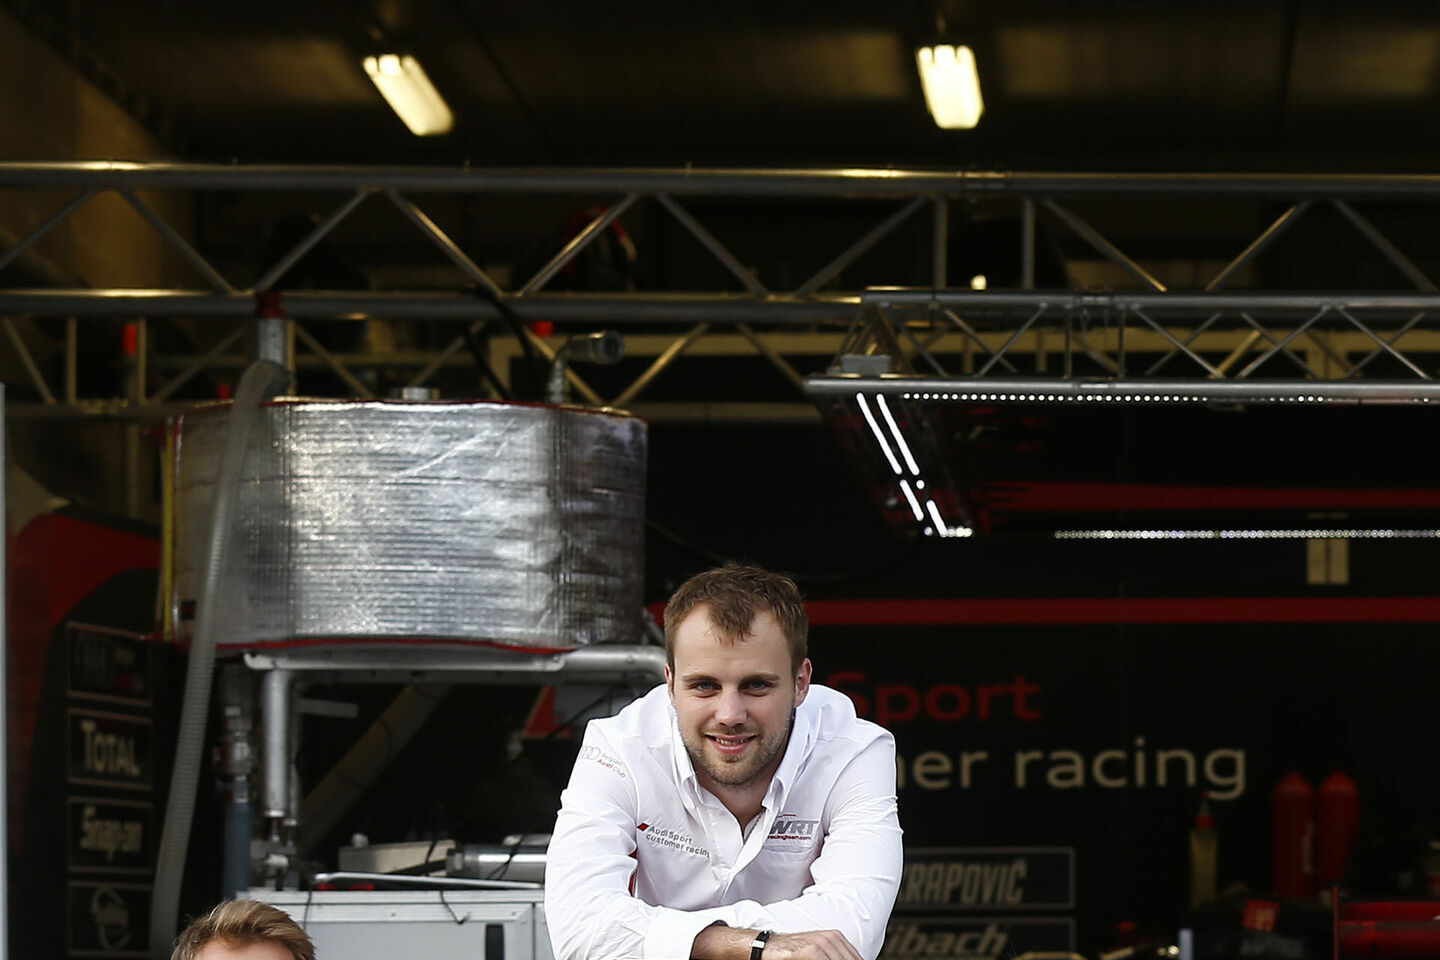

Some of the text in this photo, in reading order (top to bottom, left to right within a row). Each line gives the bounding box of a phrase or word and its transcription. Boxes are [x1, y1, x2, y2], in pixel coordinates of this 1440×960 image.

[79, 720, 142, 777] TOTAL
[896, 735, 1248, 801] er racing
[650, 826, 693, 845] Audi Sport
[770, 820, 820, 835] WRT
[645, 833, 685, 850] customer
